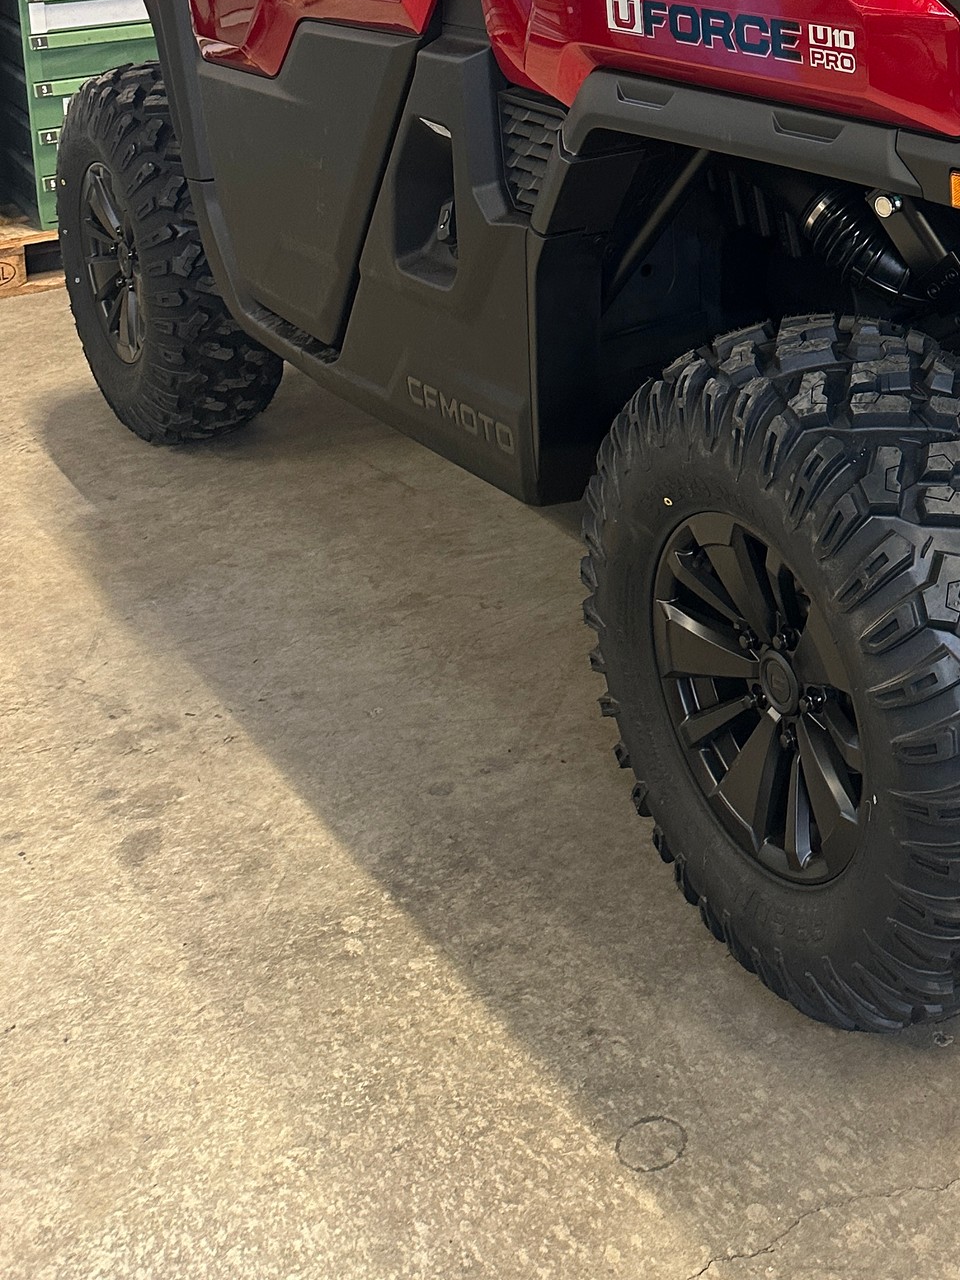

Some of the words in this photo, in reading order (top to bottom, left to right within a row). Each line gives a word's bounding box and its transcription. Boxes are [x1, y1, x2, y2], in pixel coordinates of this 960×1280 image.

[36, 38, 42, 47] 1
[808, 24, 855, 50] U10
[809, 48, 856, 74] PRO
[41, 85, 48, 95] 3
[46, 132, 52, 142] 4
[407, 375, 515, 455] CFMOTO
